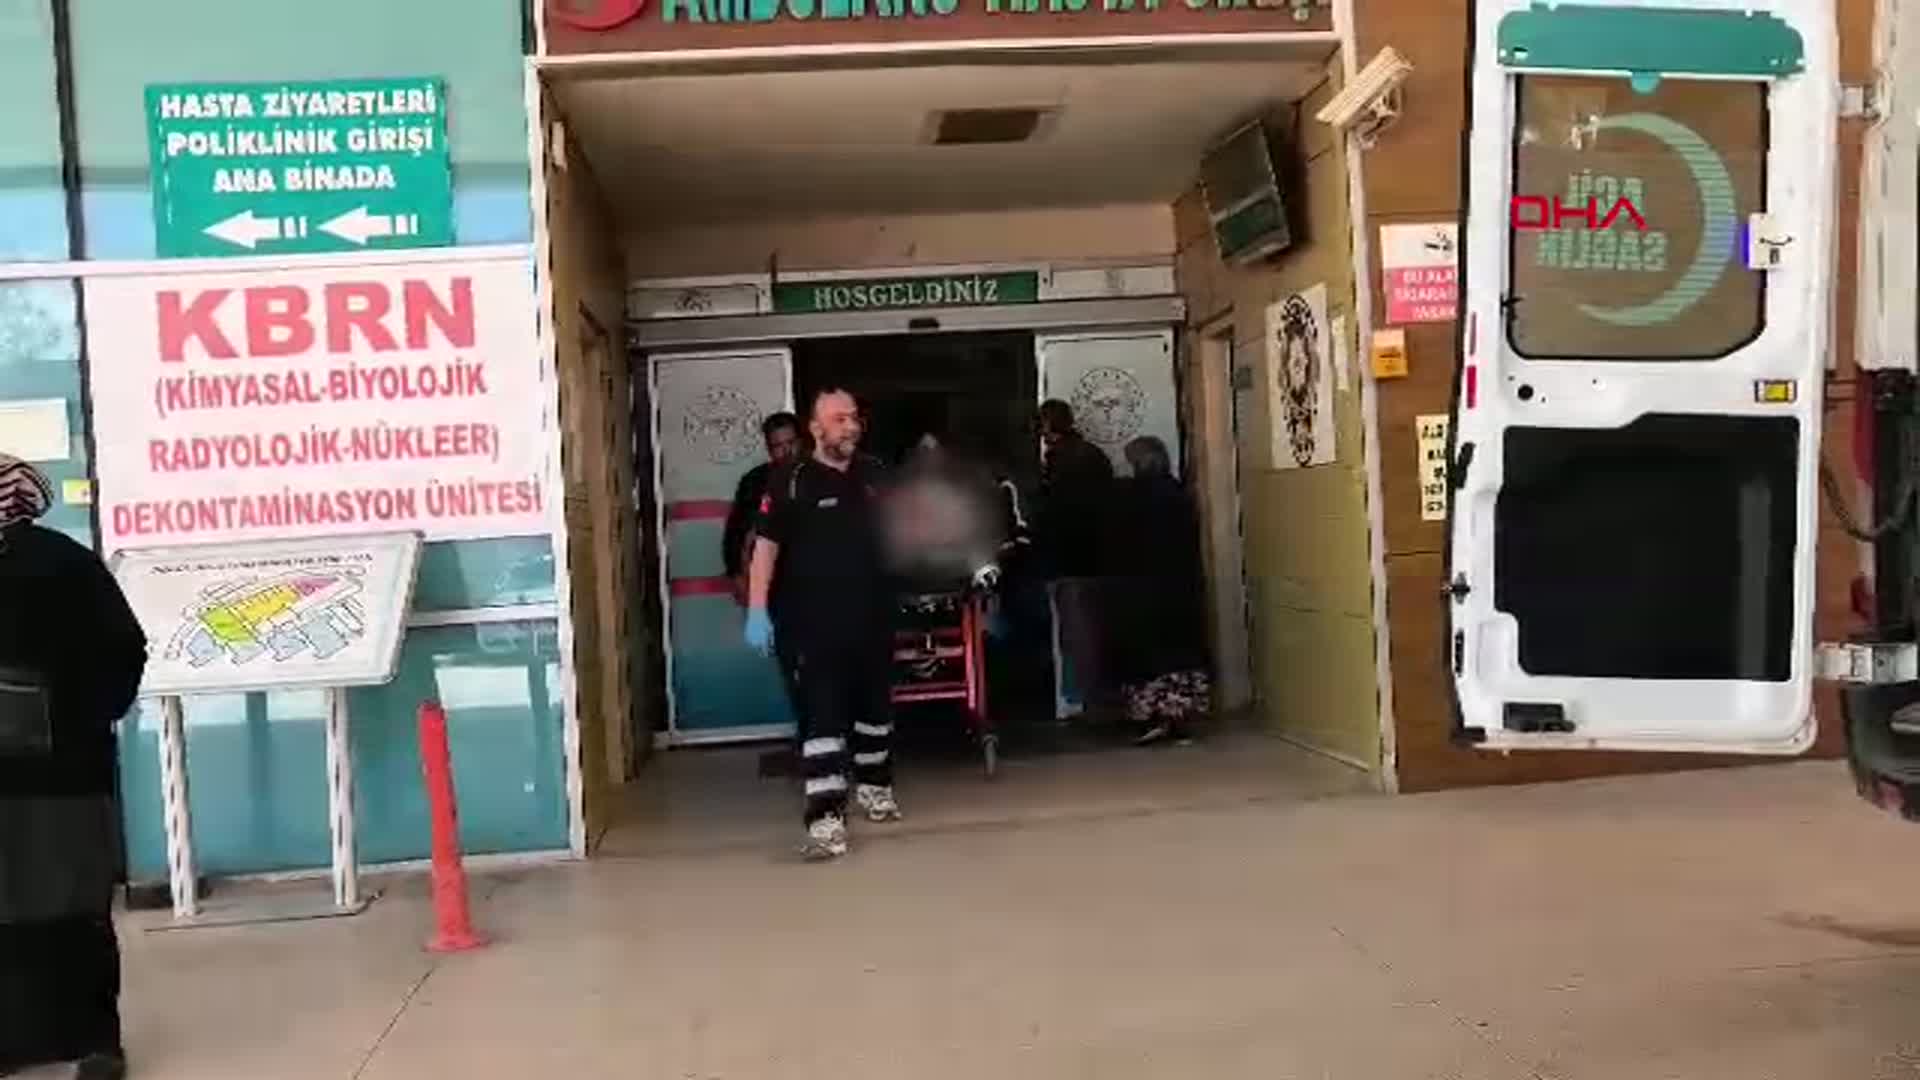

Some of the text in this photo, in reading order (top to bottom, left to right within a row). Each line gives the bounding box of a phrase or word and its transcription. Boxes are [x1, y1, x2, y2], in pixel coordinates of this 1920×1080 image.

[161, 84, 438, 119] HASTA ZİYARETLERİ
[167, 118, 433, 158] POLİKLİNİK GİRİŞİ
[212, 159, 397, 194] ANA BİNADA
[156, 276, 477, 362] KBRN
[154, 358, 488, 418] (KİMYASAL-BİYOLOJİK
[149, 420, 500, 472] RADYOLOJİK-NÜKLEER)
[113, 472, 543, 537] DEKONTAMİNASYON ÜNİTESİ
